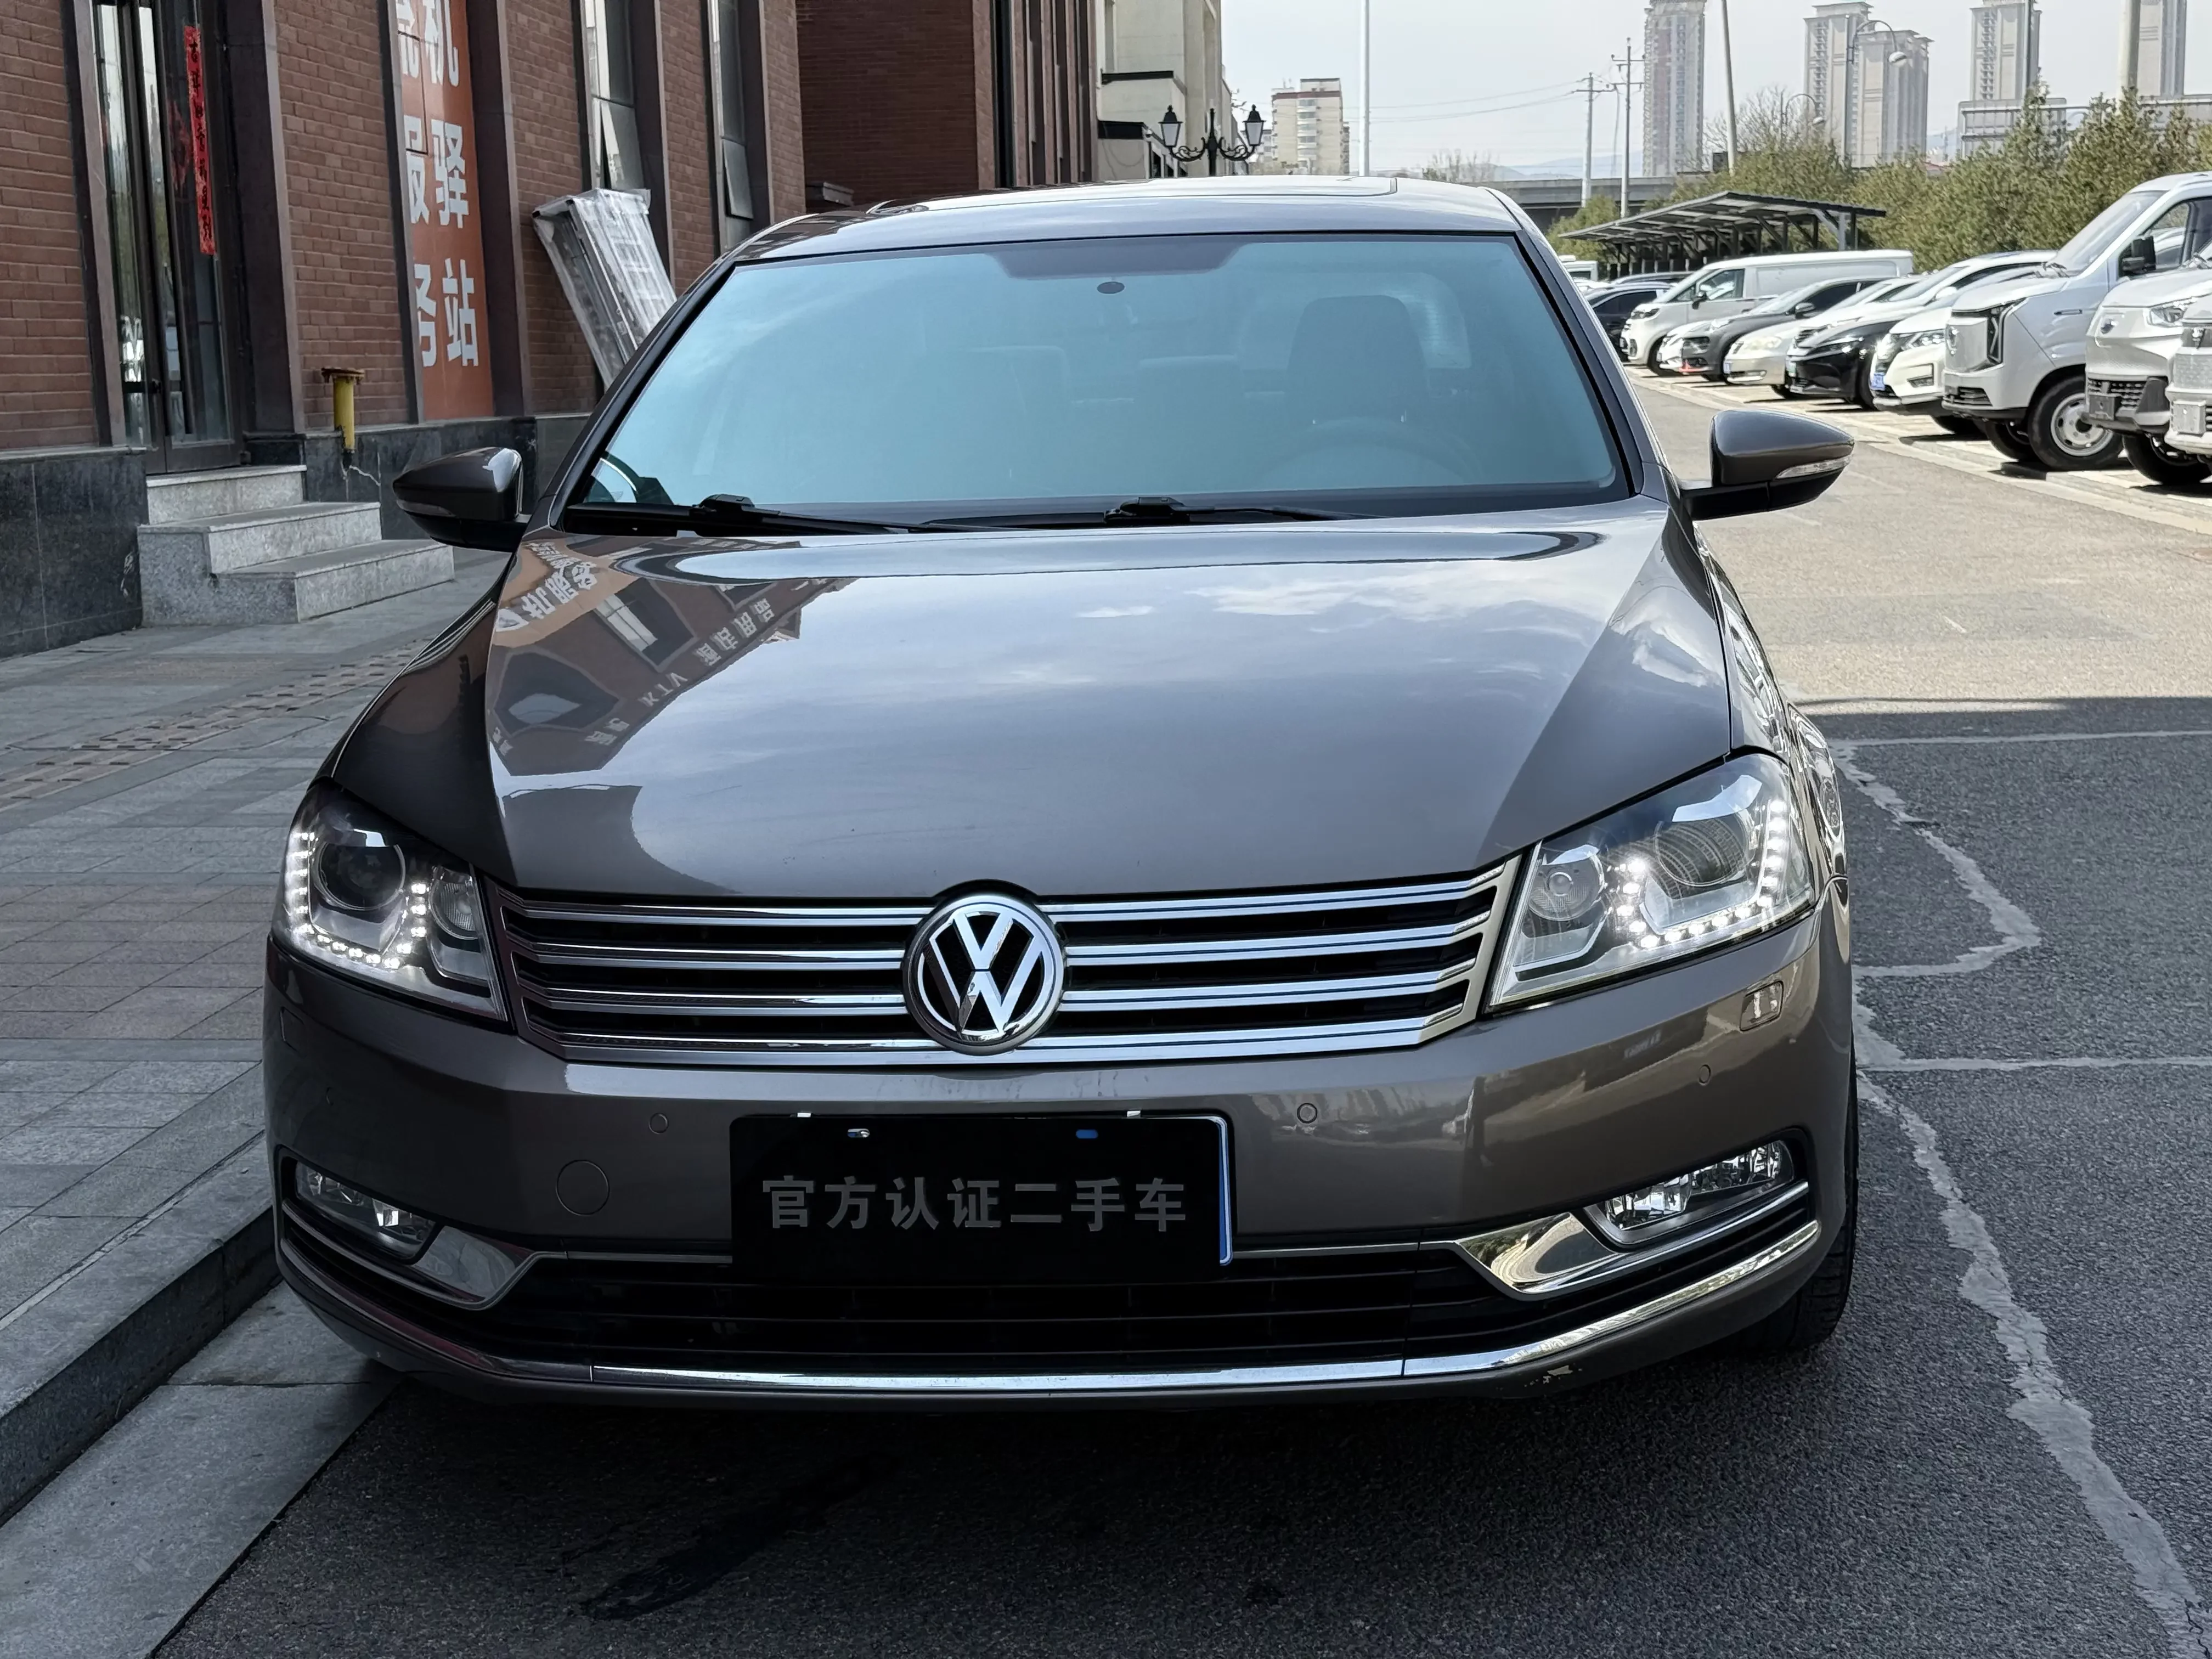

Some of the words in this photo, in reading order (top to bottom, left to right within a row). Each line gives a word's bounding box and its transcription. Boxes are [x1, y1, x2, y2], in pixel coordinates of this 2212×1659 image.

[919, 903, 1049, 1040] VW
[762, 1175, 1187, 1232] 官方认证二手车
